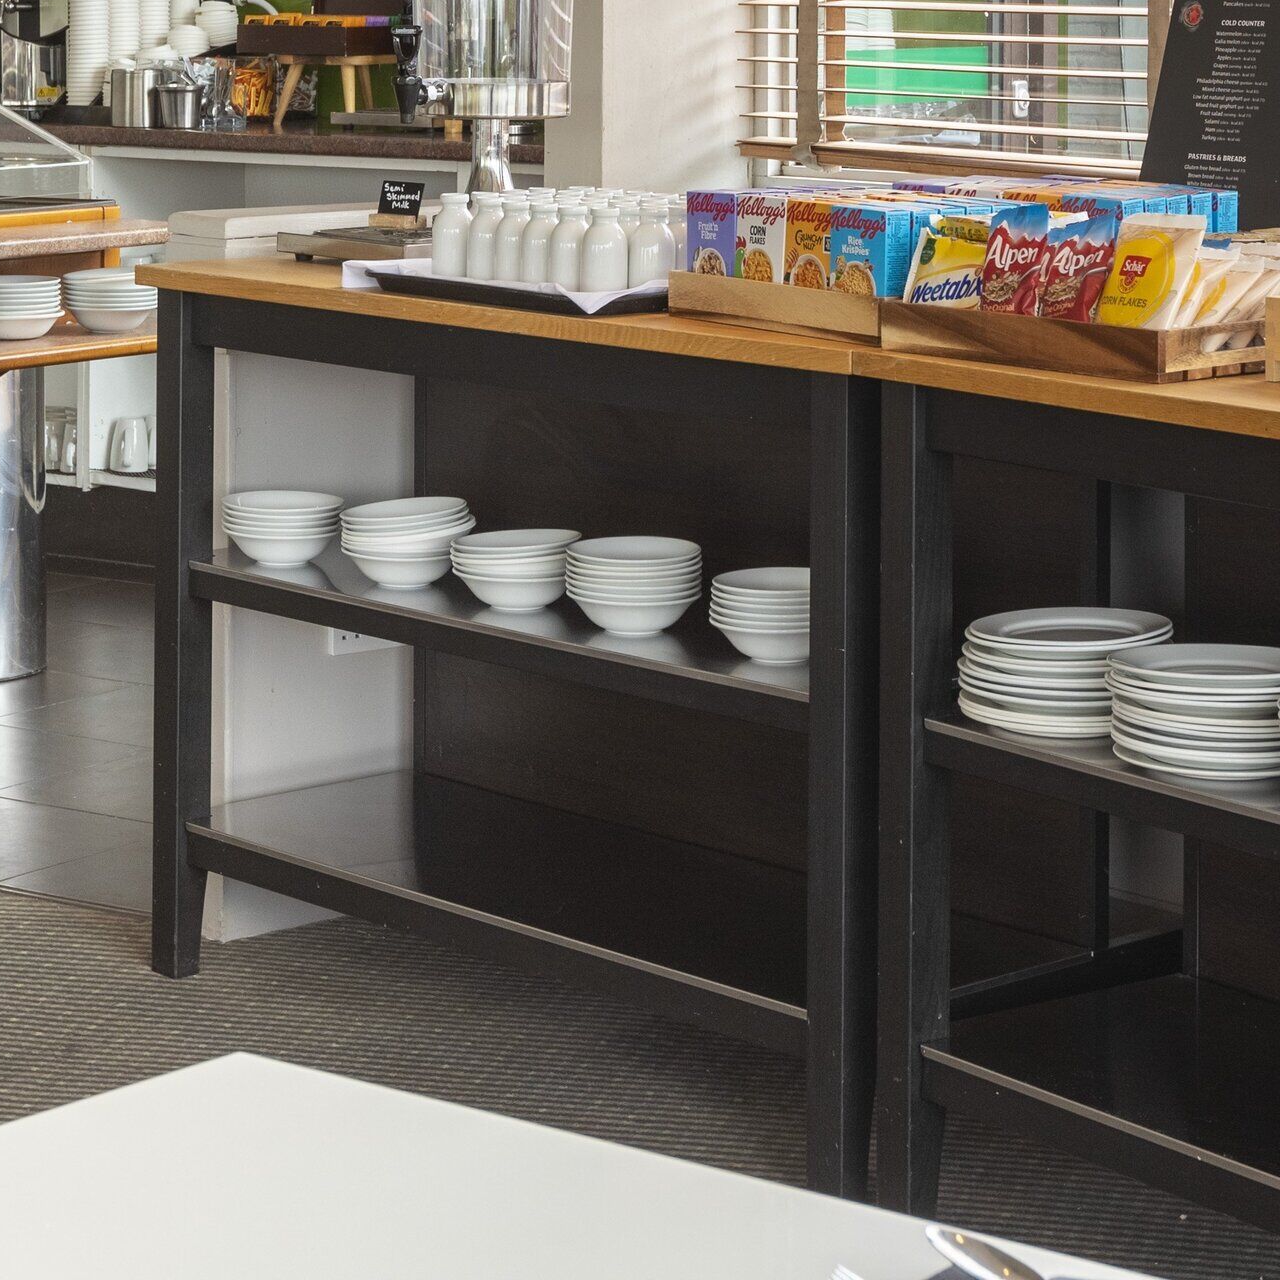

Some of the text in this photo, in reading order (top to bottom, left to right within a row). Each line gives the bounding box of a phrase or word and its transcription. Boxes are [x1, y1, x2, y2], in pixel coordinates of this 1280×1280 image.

[1188, 153, 1216, 161] PASTRIES
[384, 183, 405, 192] Semi
[387, 190, 420, 201] Skimmed
[392, 201, 409, 209] Milk
[687, 193, 735, 222] Kellogg's
[737, 196, 785, 225] Kellogg's
[787, 201, 832, 232] Kellogg
[832, 207, 886, 239] Kellogg's
[701, 230, 716, 240] Fibre
[750, 225, 766, 236] CORN
[750, 237, 765, 245] FLAKES
[847, 236, 863, 246] Rice
[983, 235, 1039, 271] Alpen
[1048, 246, 1104, 276] Alpen
[1123, 260, 1146, 275] Schär
[1120, 297, 1147, 308] FLAKES
